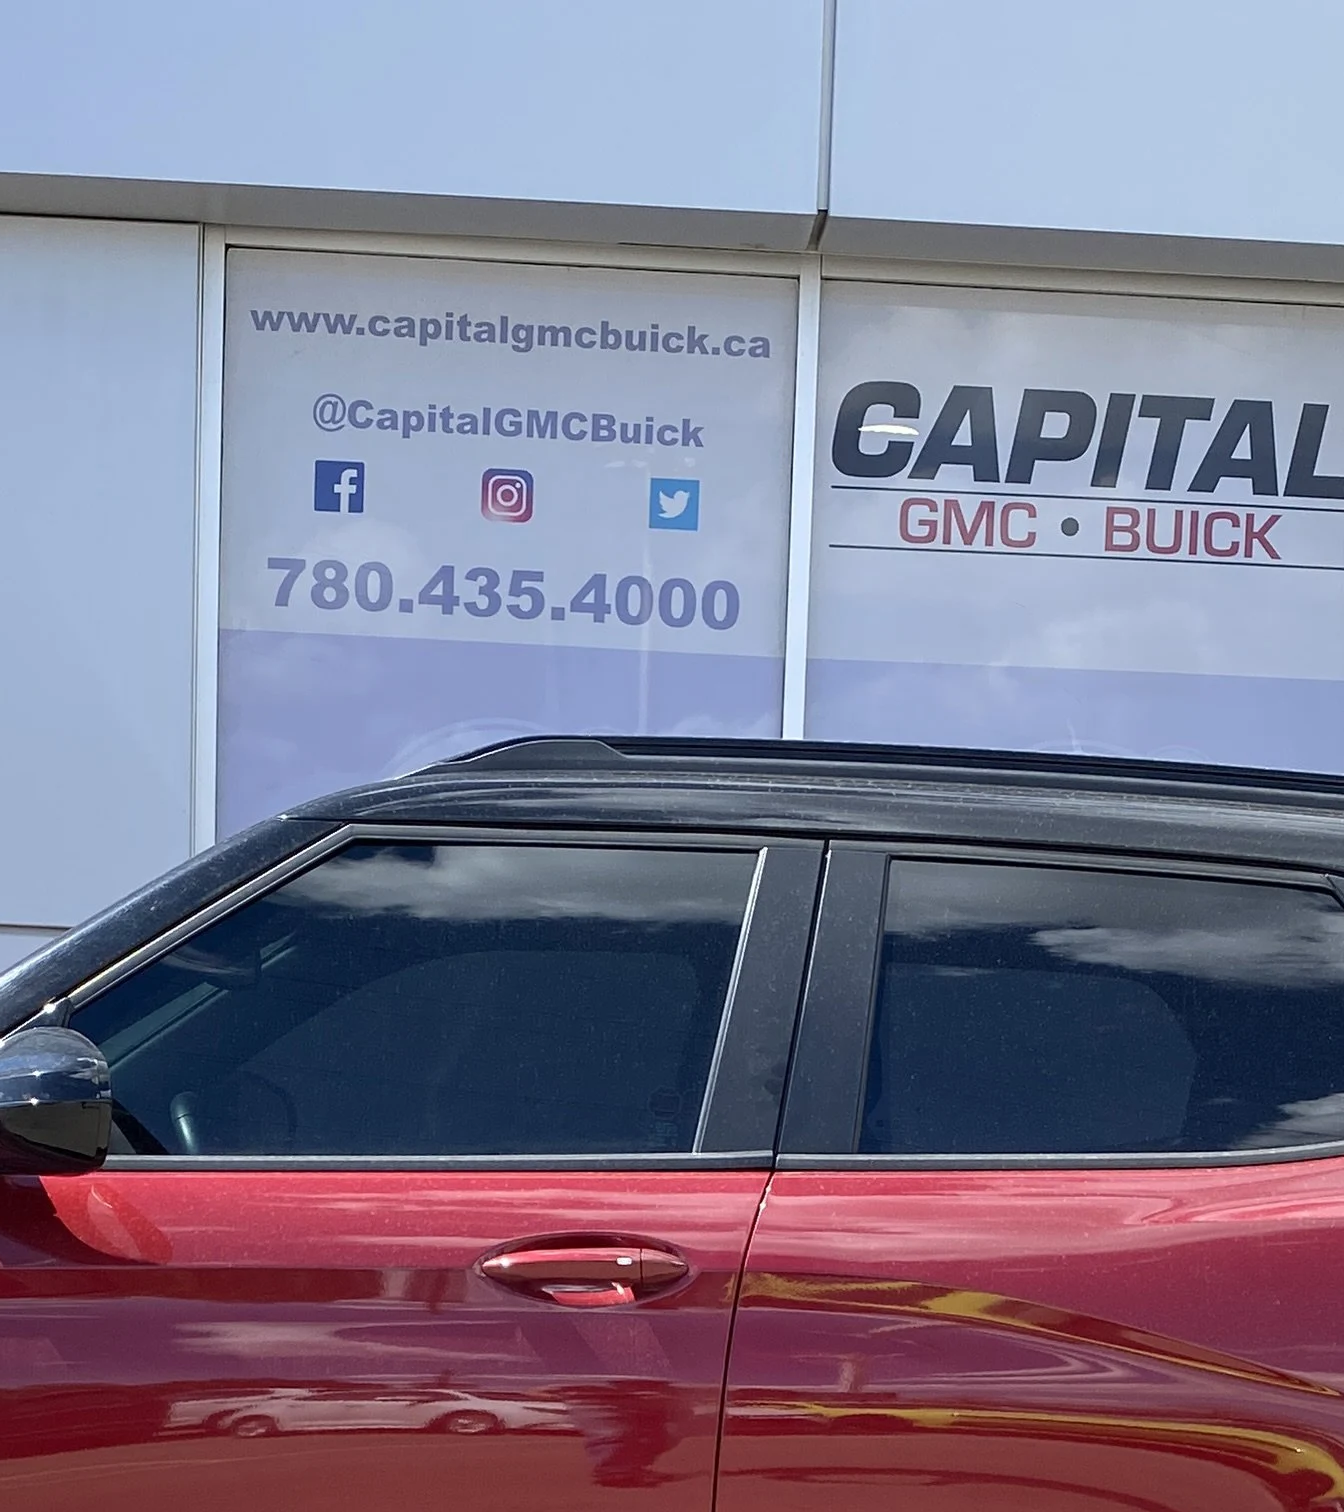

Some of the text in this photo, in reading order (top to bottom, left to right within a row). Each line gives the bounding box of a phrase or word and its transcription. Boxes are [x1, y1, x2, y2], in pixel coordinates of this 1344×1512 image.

[251, 310, 771, 359] www.capitalgmcbuick.ca
[313, 393, 704, 448] @CapitalGMCBuick
[898, 498, 1282, 560] GMC BUICK
[266, 557, 740, 631] 780.435.4000
